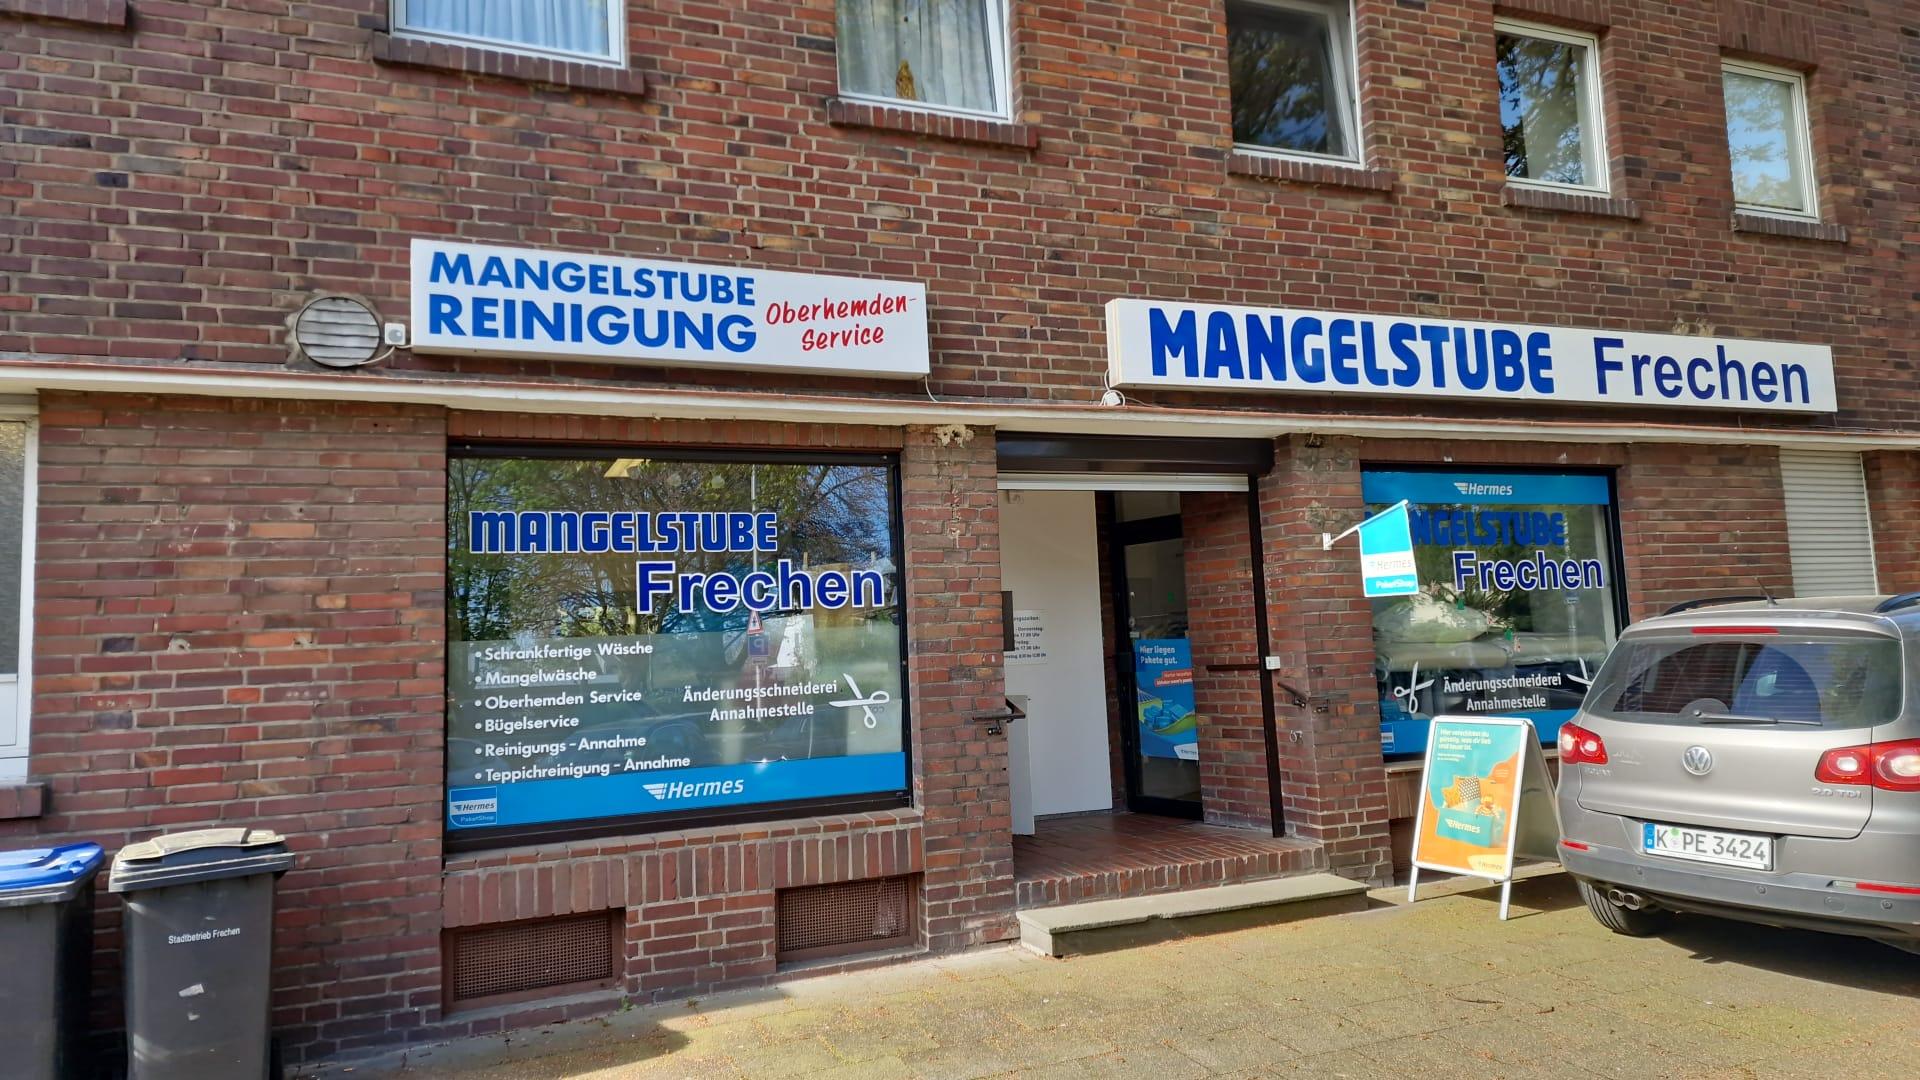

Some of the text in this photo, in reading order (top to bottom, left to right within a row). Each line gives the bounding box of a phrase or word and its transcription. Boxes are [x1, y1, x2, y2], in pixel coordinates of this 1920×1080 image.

[428, 251, 757, 308] MANGELSTUBE
[766, 293, 917, 325] Oberhemden-
[428, 293, 758, 355] REINIGUNG
[802, 324, 884, 352] Service
[1148, 307, 1810, 404] MANGELSTUBE Frechen
[1468, 482, 1513, 496] Hermes
[469, 511, 778, 553] MANGELSTUBE
[1453, 549, 1605, 592] Frechen
[636, 558, 886, 615] Frechen
[485, 641, 653, 661] Schrankfertige Wäsche
[1140, 645, 1176, 656] Hier liegen
[1140, 656, 1178, 666] Pakete gut.
[485, 668, 597, 687] Mangelwäsche
[1443, 673, 1562, 693] Änderungsschneiderei
[485, 689, 642, 710] Oberhemden Service
[683, 680, 837, 702] Änderungsschneiderei
[709, 701, 814, 721] Annahmestelle
[1466, 694, 1547, 711] Annahmestelle
[485, 716, 580, 735] Bügelservice
[485, 761, 610, 783] Teppichreinigung
[624, 755, 690, 772] Annahme
[667, 779, 745, 799] Hermes
[462, 802, 495, 811] Hermes
[1656, 829, 1767, 861] K PE 3424
[168, 927, 240, 944] Stadtbetrieb Frechen
